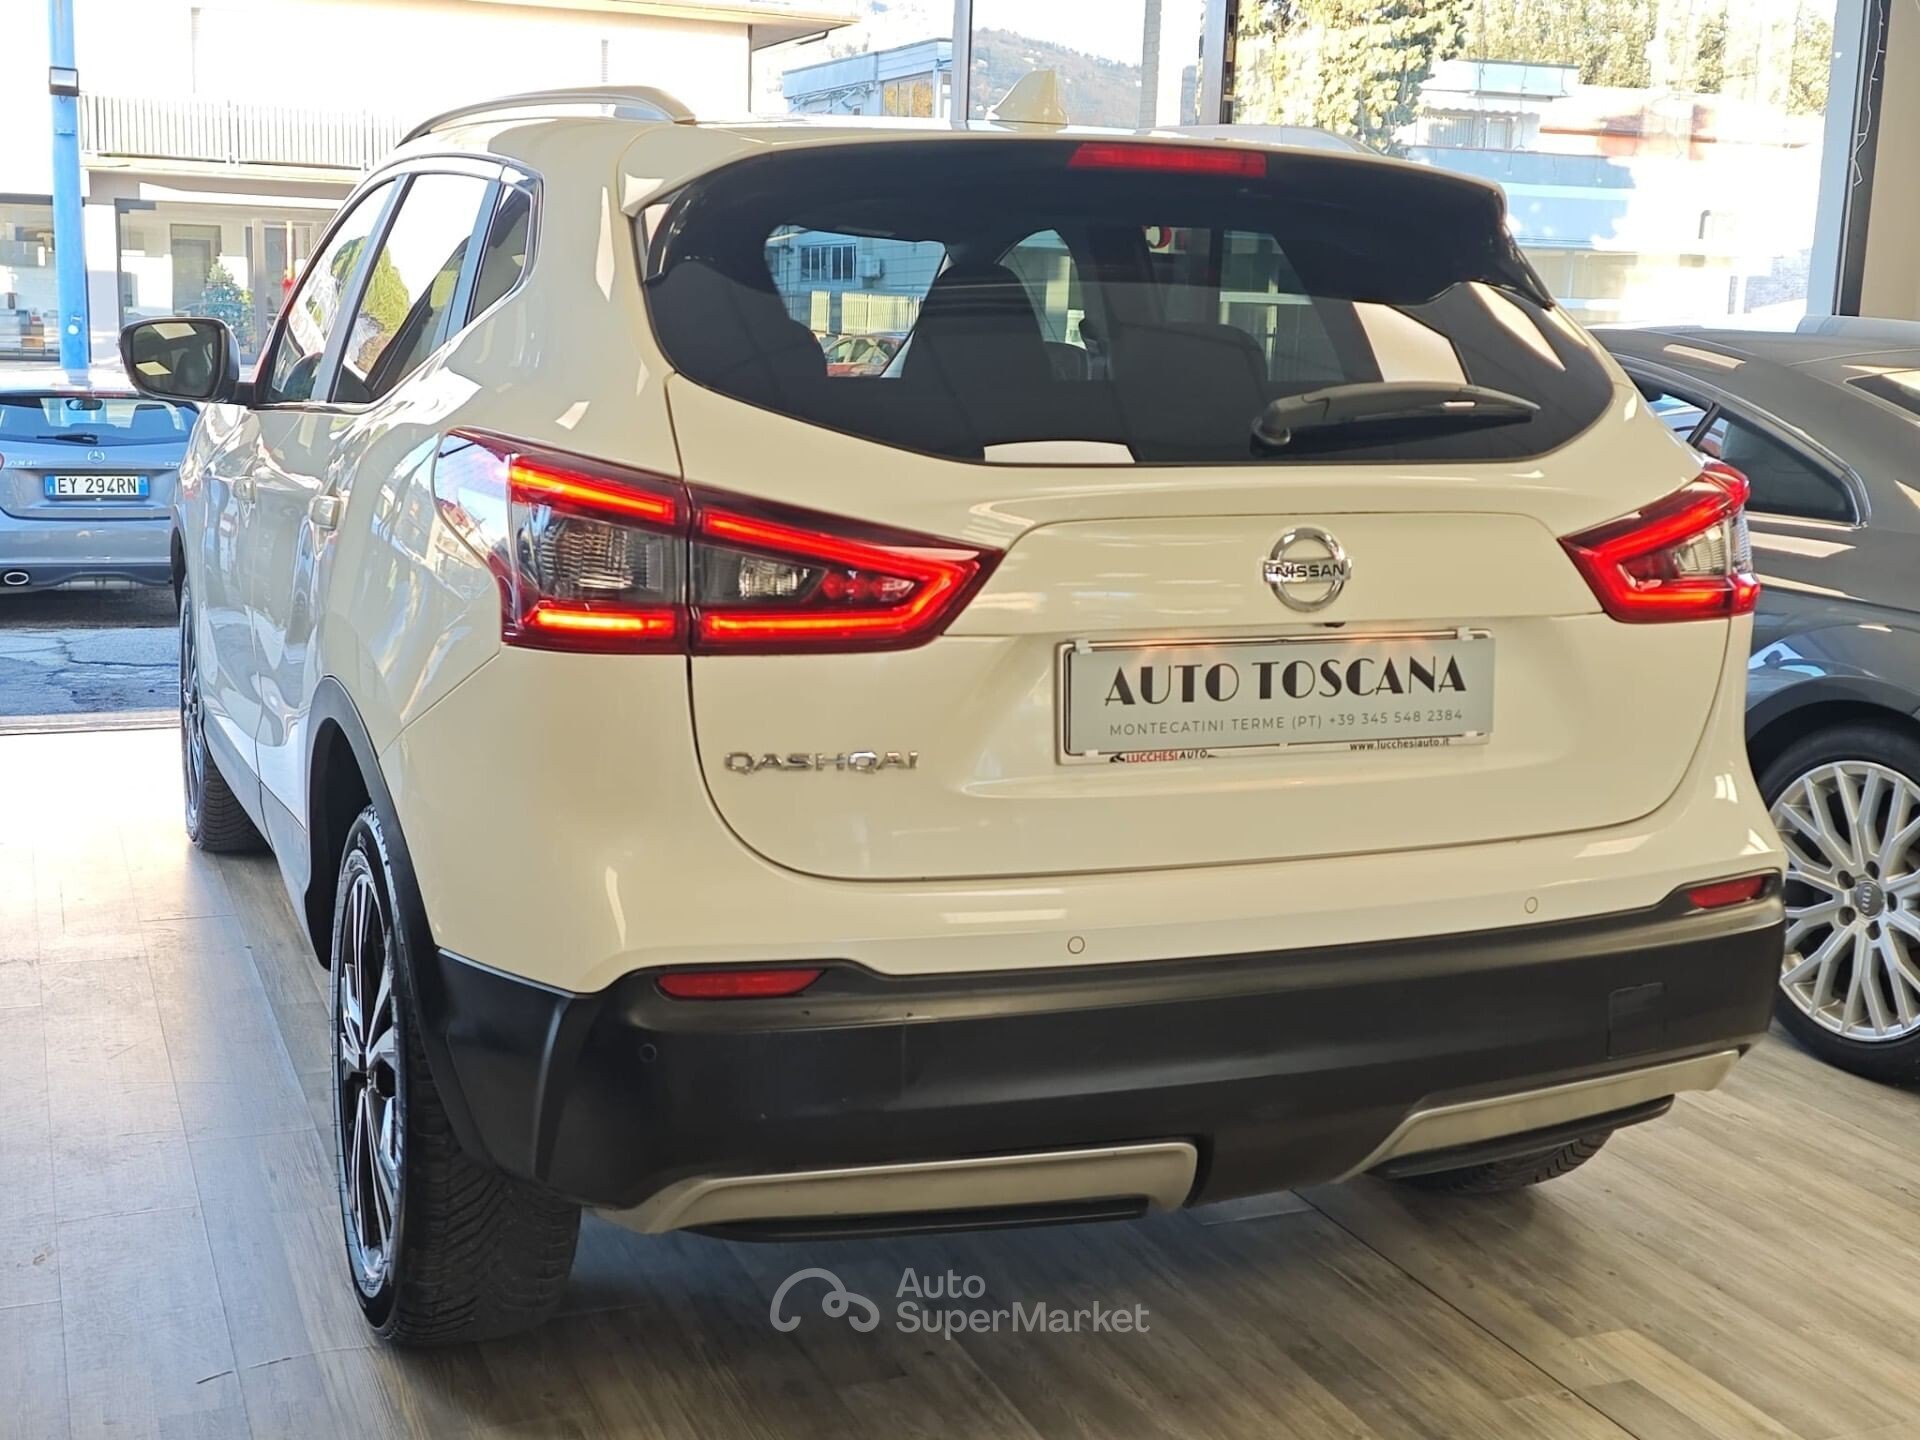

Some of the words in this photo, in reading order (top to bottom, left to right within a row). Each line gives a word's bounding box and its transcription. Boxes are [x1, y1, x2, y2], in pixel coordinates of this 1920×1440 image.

[58, 478, 77, 494] EY
[85, 477, 137, 494] 294RN
[1275, 564, 1344, 578] NISSAN
[1105, 663, 1240, 707] AUTO
[1251, 655, 1467, 700] TOSCANA
[1109, 719, 1225, 736] MONTECATINI
[1231, 716, 1285, 731] TERME
[1292, 714, 1322, 729] (PT)
[1329, 713, 1355, 726] +39
[1361, 712, 1388, 725] 345
[1394, 710, 1422, 724] 548
[1427, 708, 1463, 722] 2384
[1350, 737, 1450, 751] www.lucchesiauto.it
[724, 751, 919, 775] QASHQAI
